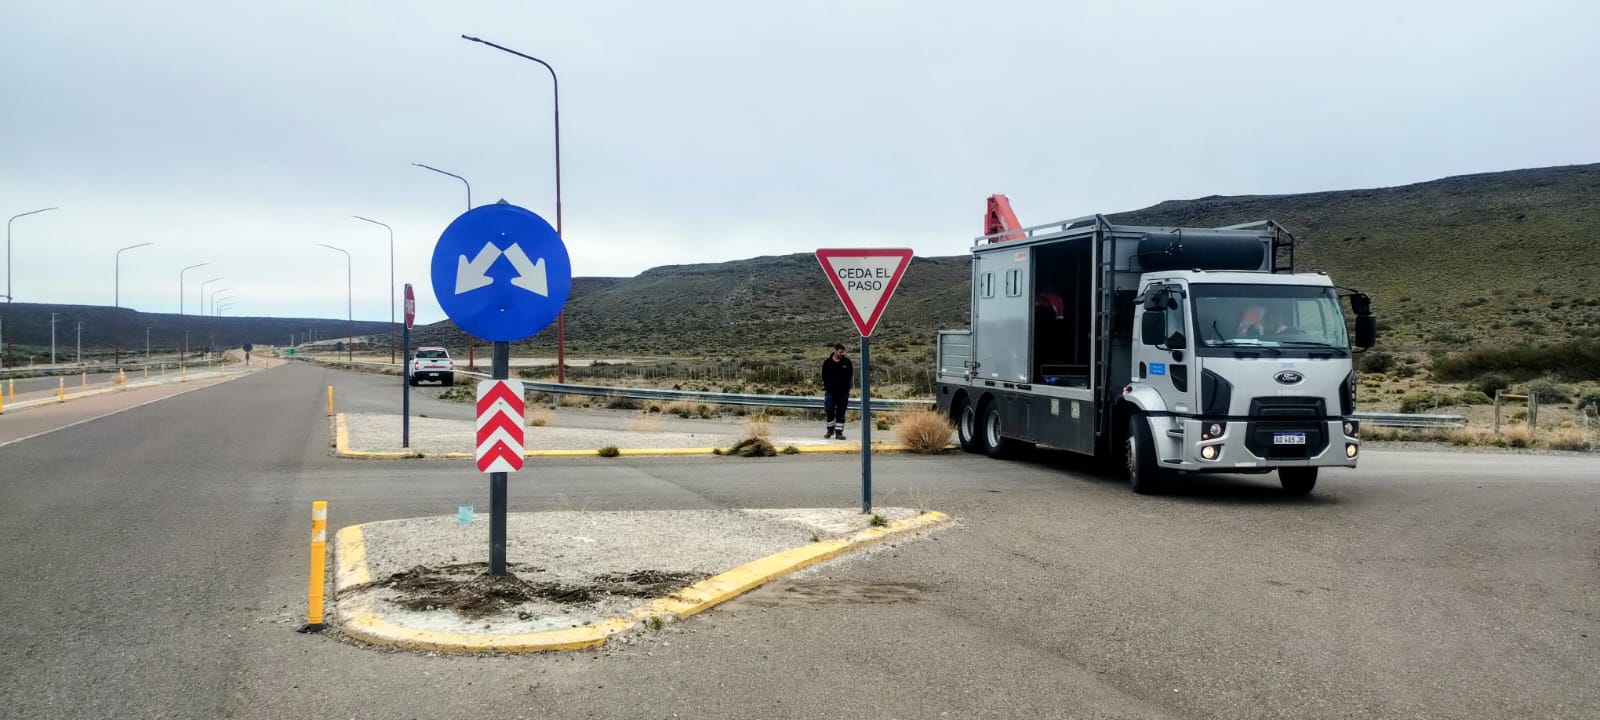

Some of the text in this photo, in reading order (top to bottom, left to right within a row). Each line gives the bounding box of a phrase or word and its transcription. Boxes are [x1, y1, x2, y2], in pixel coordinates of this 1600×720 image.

[838, 268, 891, 278] CEDA EL
[848, 281, 882, 291] PASO
[1282, 373, 1298, 381] Ford
